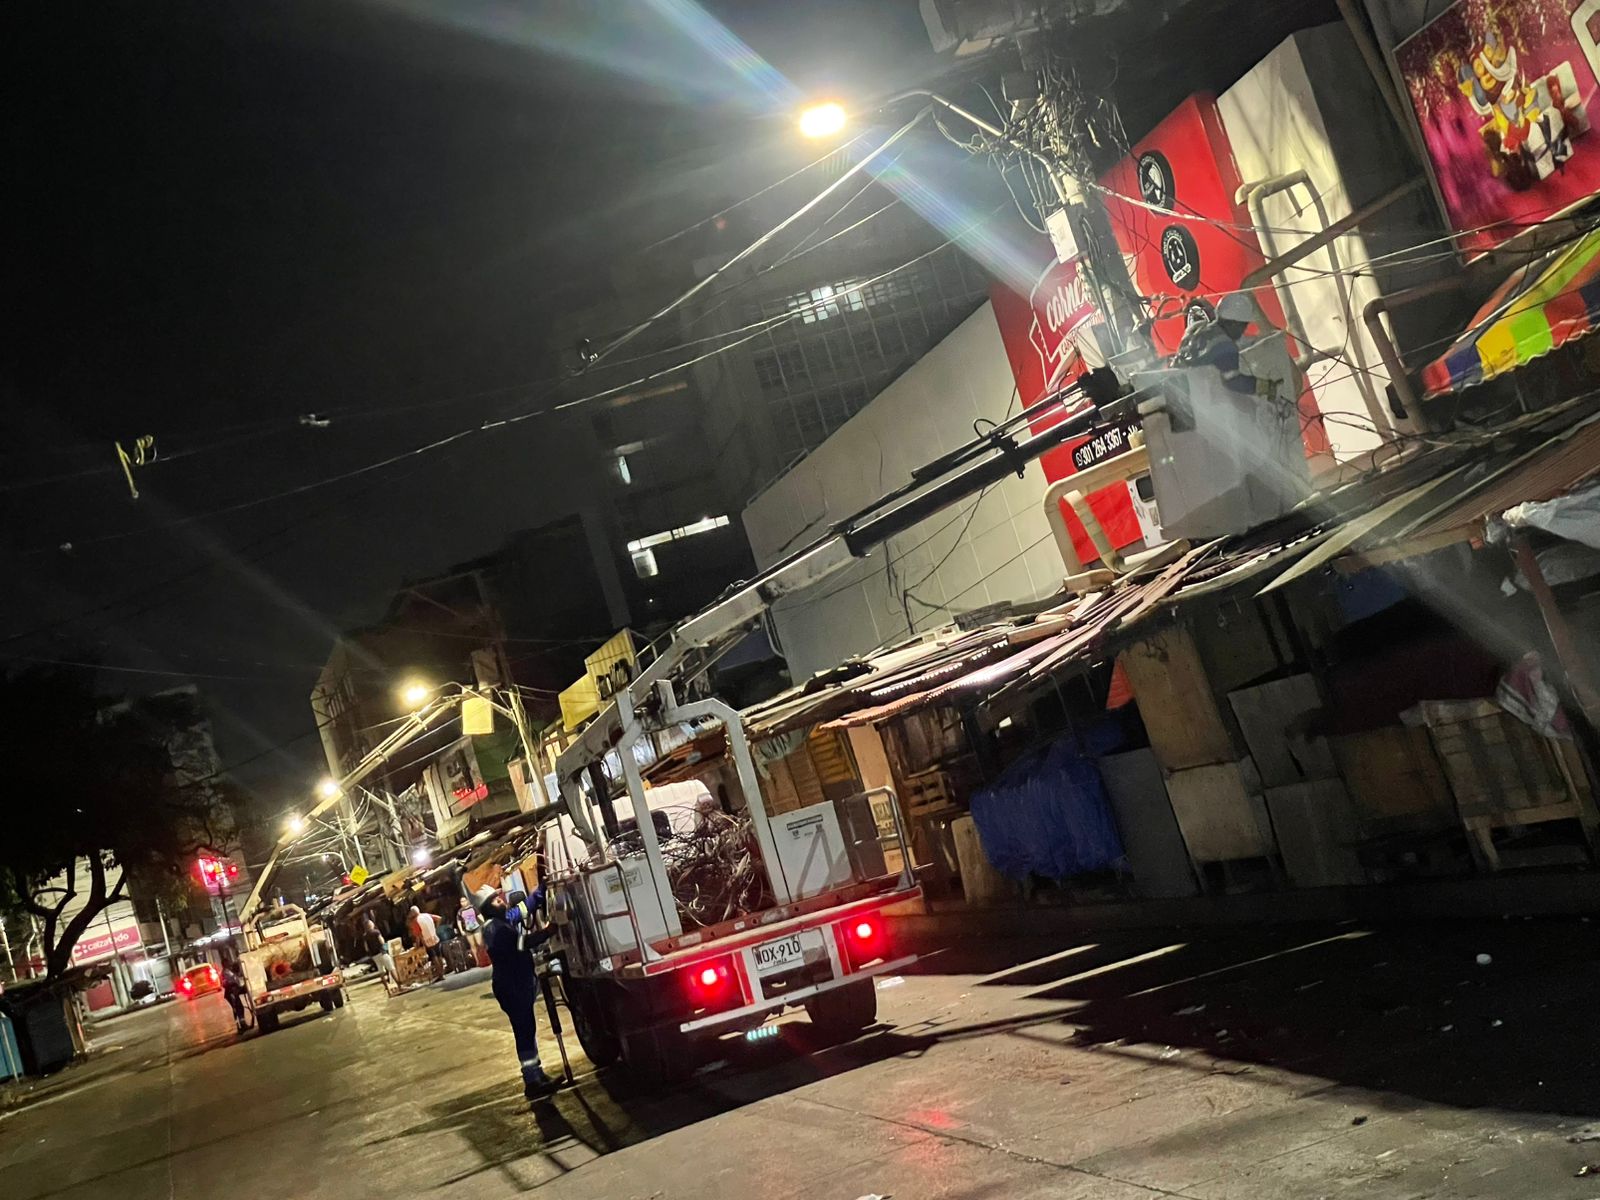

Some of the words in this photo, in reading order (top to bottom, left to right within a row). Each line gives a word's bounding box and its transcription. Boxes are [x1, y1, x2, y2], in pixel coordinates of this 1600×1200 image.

[1080, 444, 1095, 465] 301
[1092, 436, 1108, 458] 264
[1104, 427, 1123, 451] 3367
